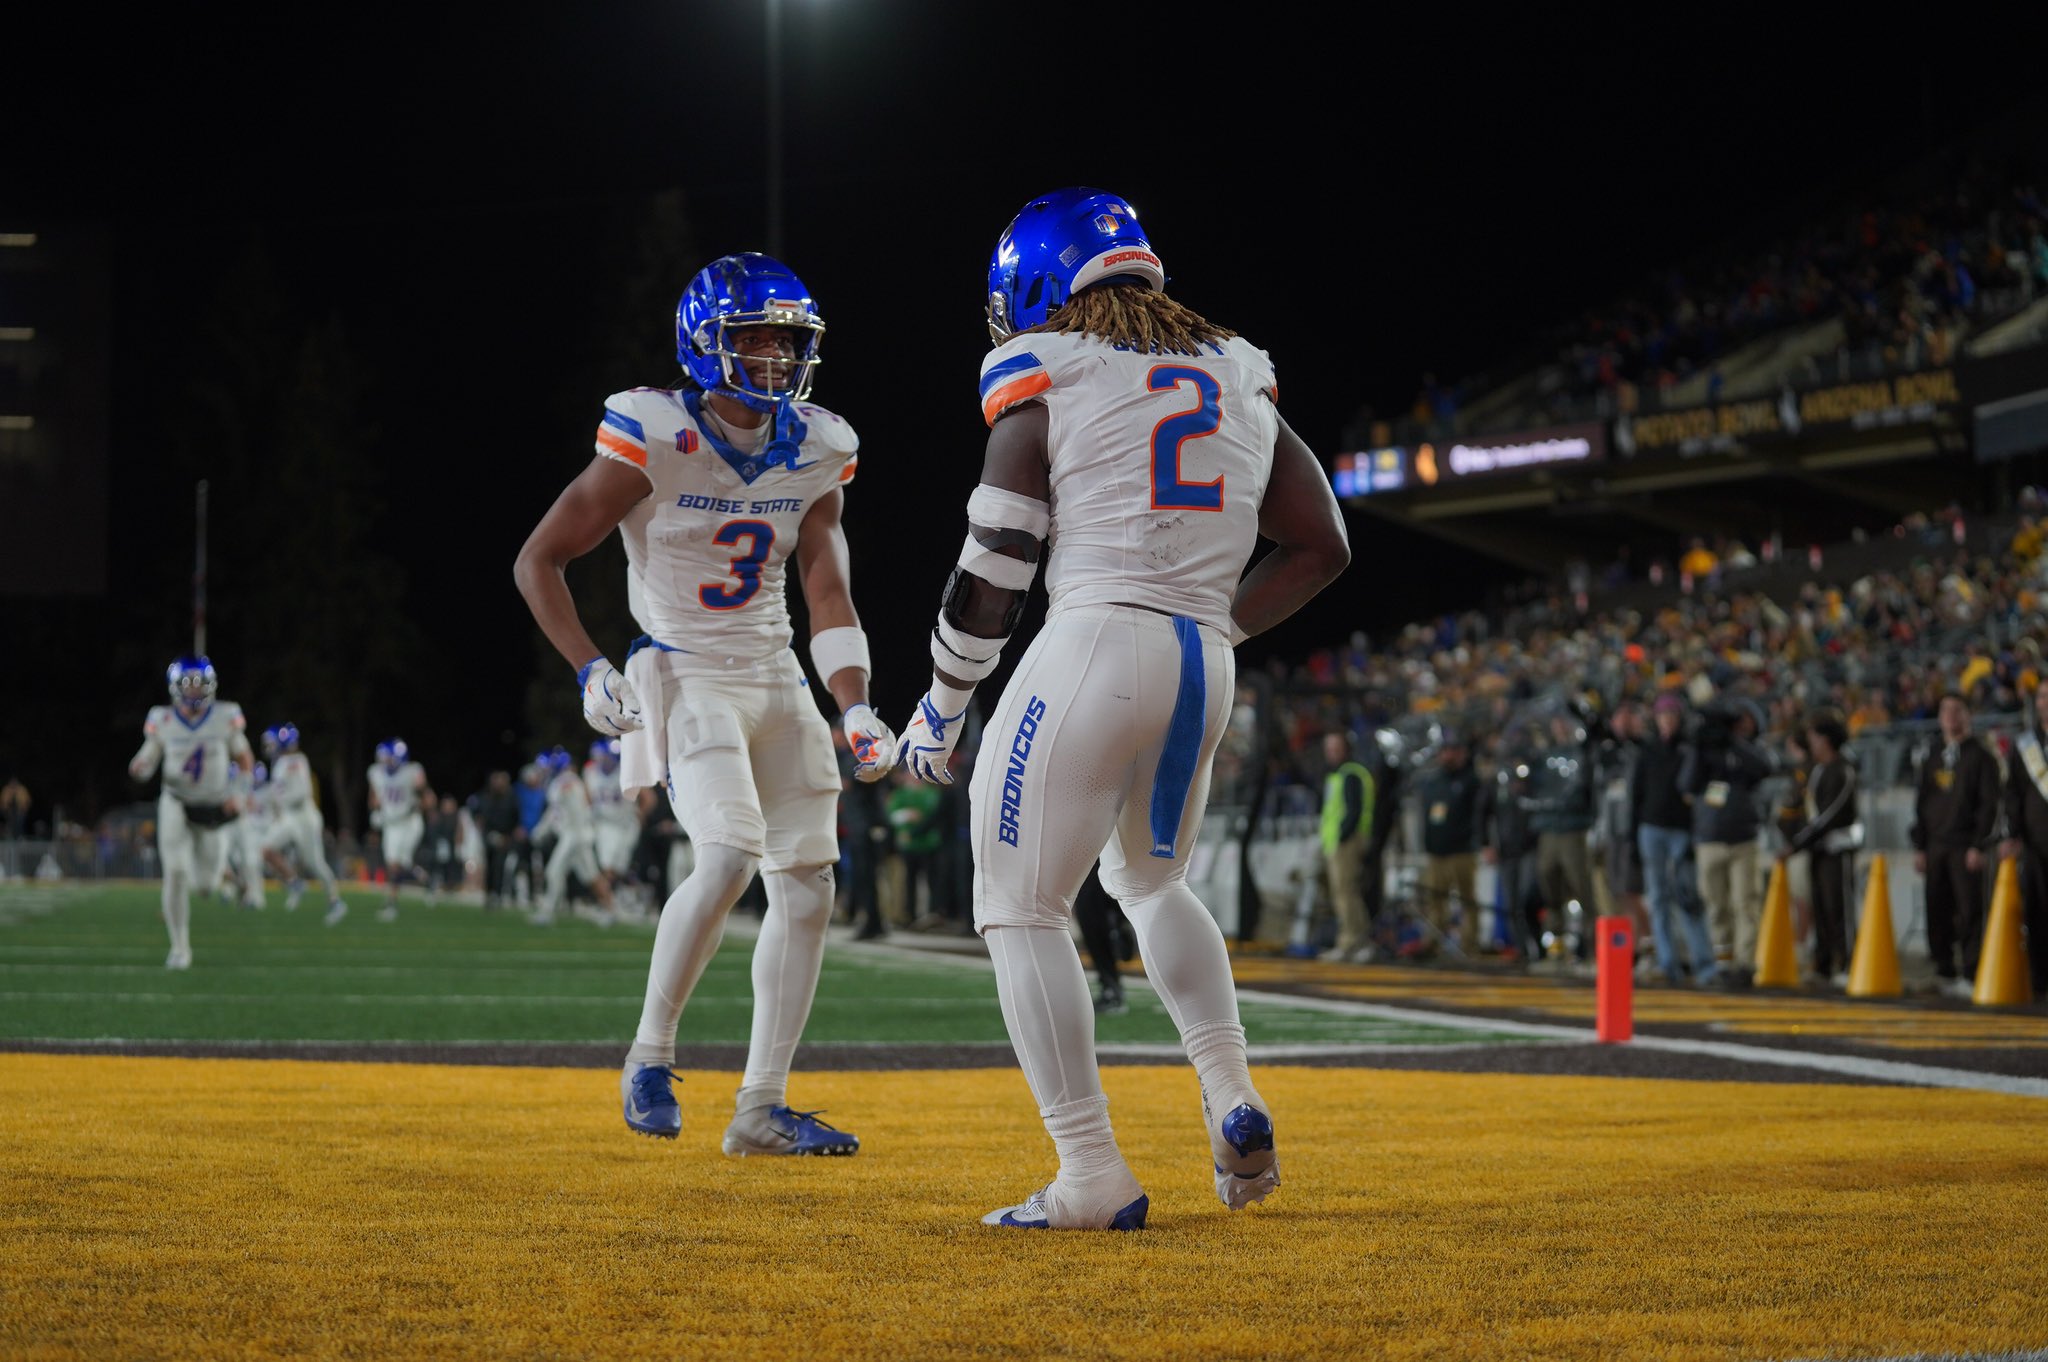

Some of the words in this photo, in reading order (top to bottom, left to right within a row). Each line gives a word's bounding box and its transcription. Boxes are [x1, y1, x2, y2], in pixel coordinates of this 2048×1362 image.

[1103, 251, 1160, 267] BRONCOS
[1147, 364, 1224, 511] 2
[677, 494, 745, 514] BOISE
[750, 498, 804, 514] STATE
[699, 519, 776, 611] 3
[183, 743, 205, 784] 4
[999, 695, 1046, 848] BRONCOS
